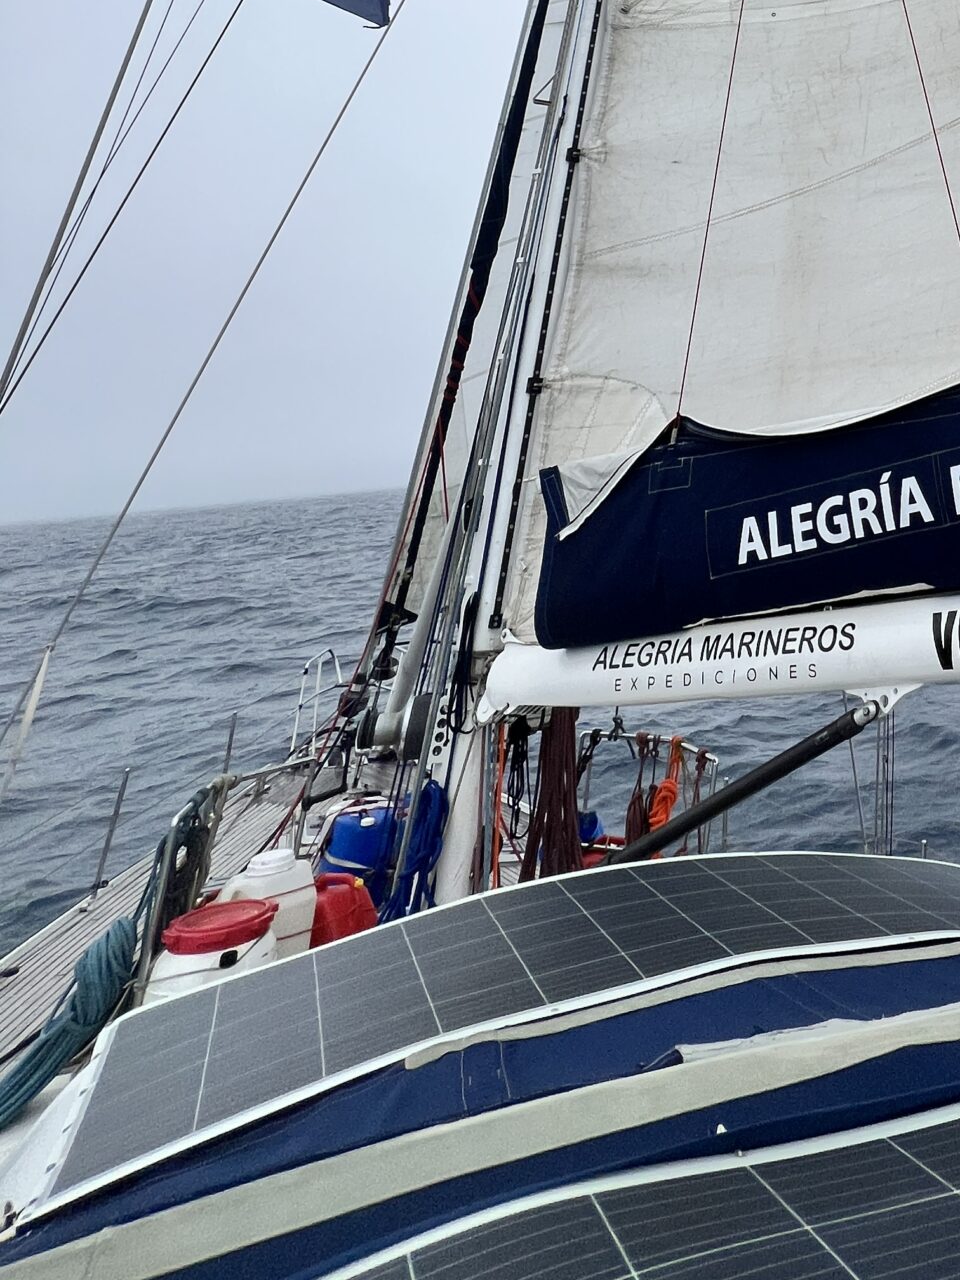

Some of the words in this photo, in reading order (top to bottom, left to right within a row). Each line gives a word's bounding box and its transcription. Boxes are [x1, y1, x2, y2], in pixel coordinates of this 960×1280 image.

[737, 471, 932, 566] ALEGRÍA
[592, 637, 693, 671] ALEGRIA
[700, 622, 856, 661] MARINEROS
[614, 663, 818, 692] EXPEDICIONES
